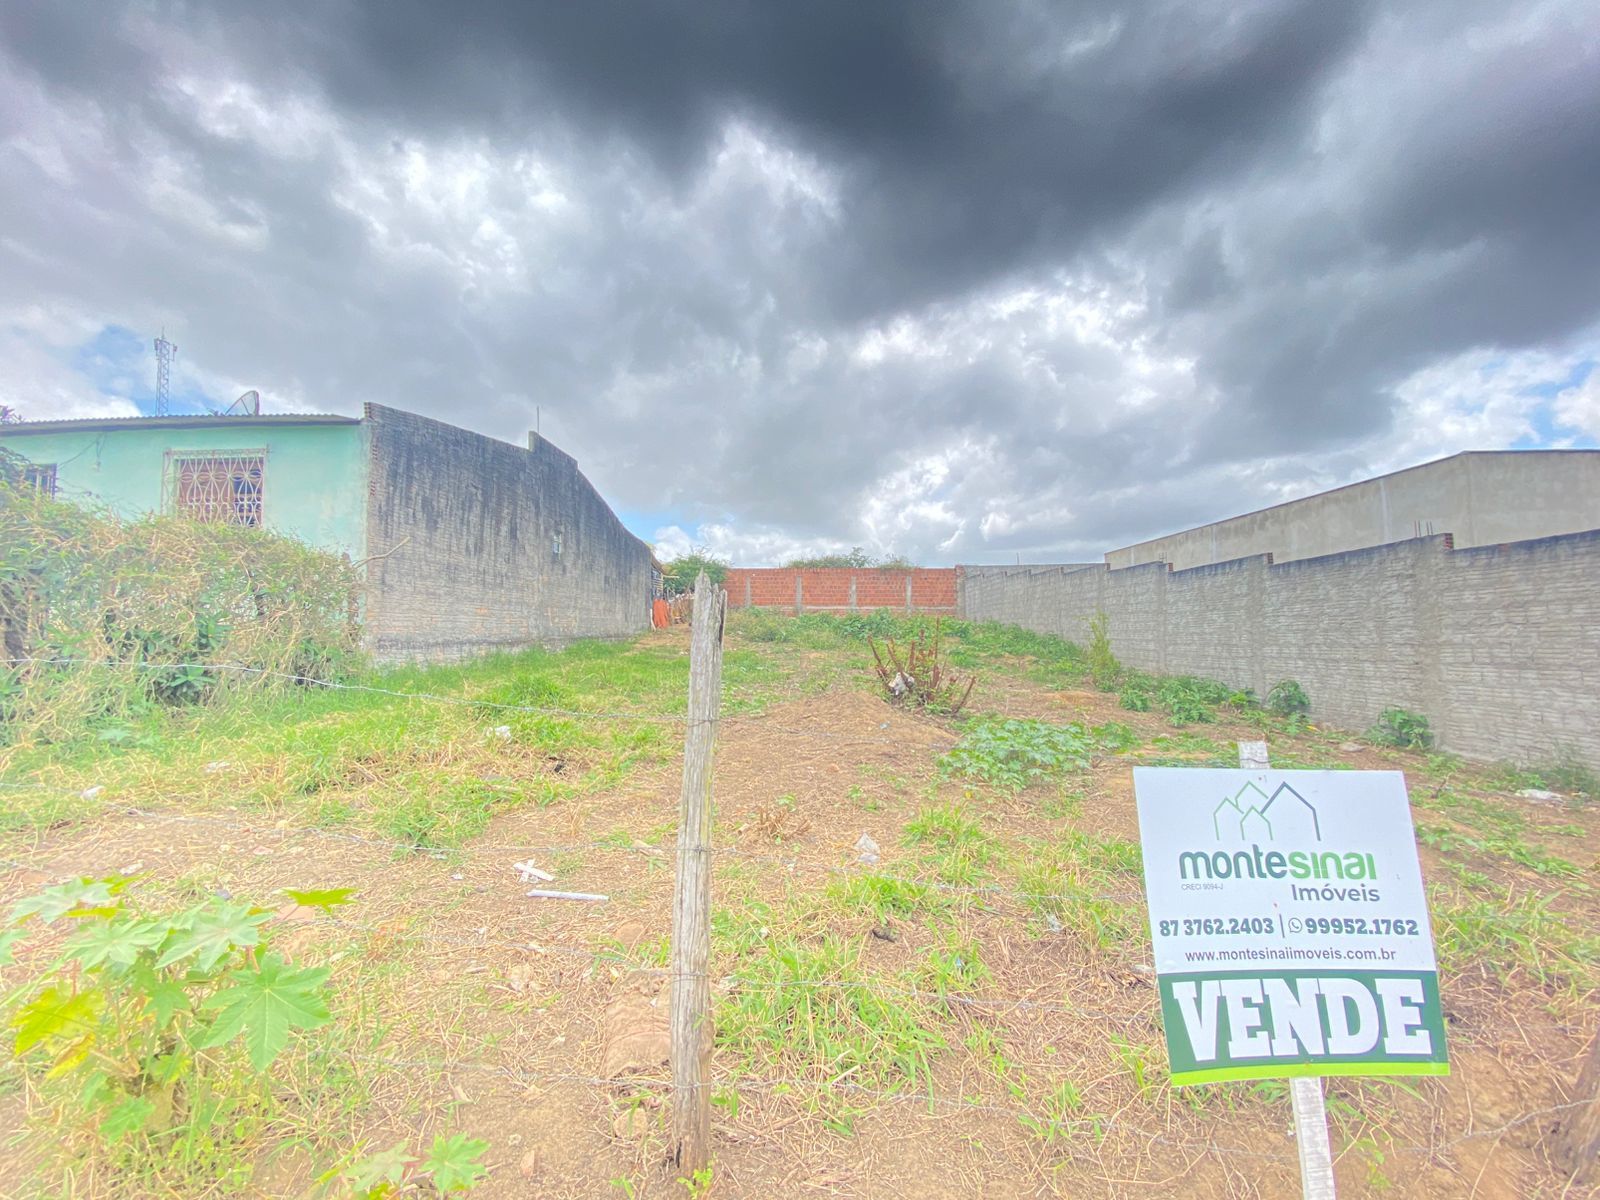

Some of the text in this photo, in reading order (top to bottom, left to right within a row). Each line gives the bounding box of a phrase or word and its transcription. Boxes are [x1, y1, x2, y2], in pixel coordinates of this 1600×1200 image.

[1291, 884, 1380, 902] Imóveis
[1159, 917, 1419, 936] 87 3762.2403 99952.1762
[1185, 947, 1396, 963] www.montesinaiimoveis.com.br
[1171, 978, 1433, 1061] VENDE
